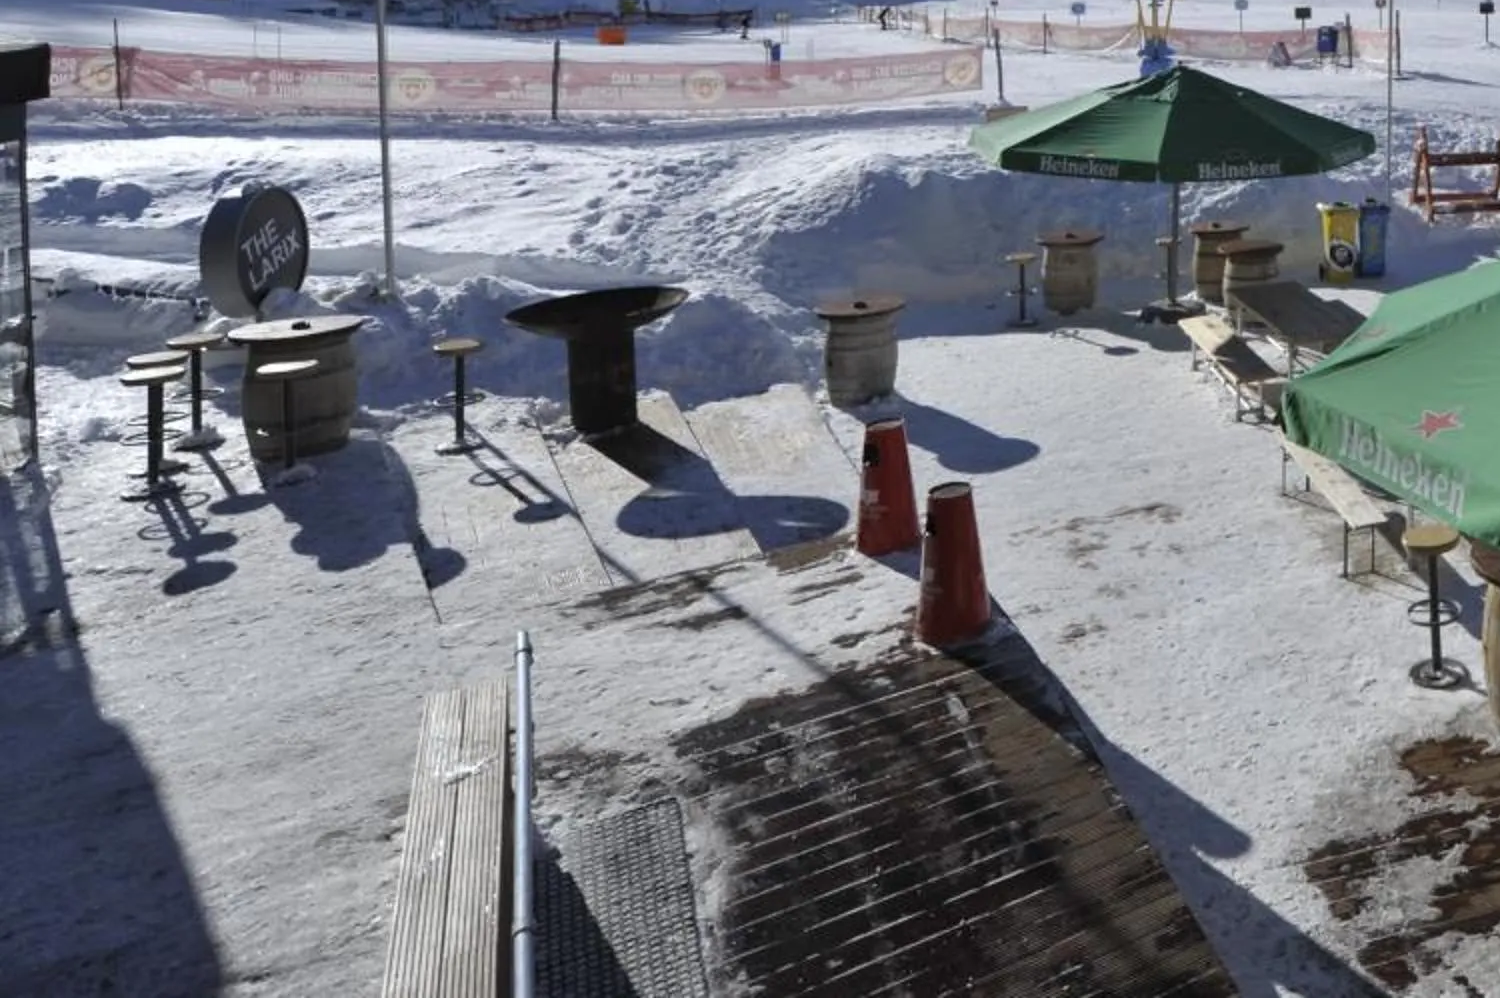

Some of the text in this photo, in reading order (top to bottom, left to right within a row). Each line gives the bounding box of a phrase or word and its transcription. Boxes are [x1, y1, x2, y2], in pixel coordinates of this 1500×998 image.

[1040, 155, 1119, 178] Heineken
[1198, 159, 1281, 180] Heineken
[241, 217, 278, 262] THE
[249, 227, 301, 291] LARIX
[1339, 415, 1464, 519] Heineken
